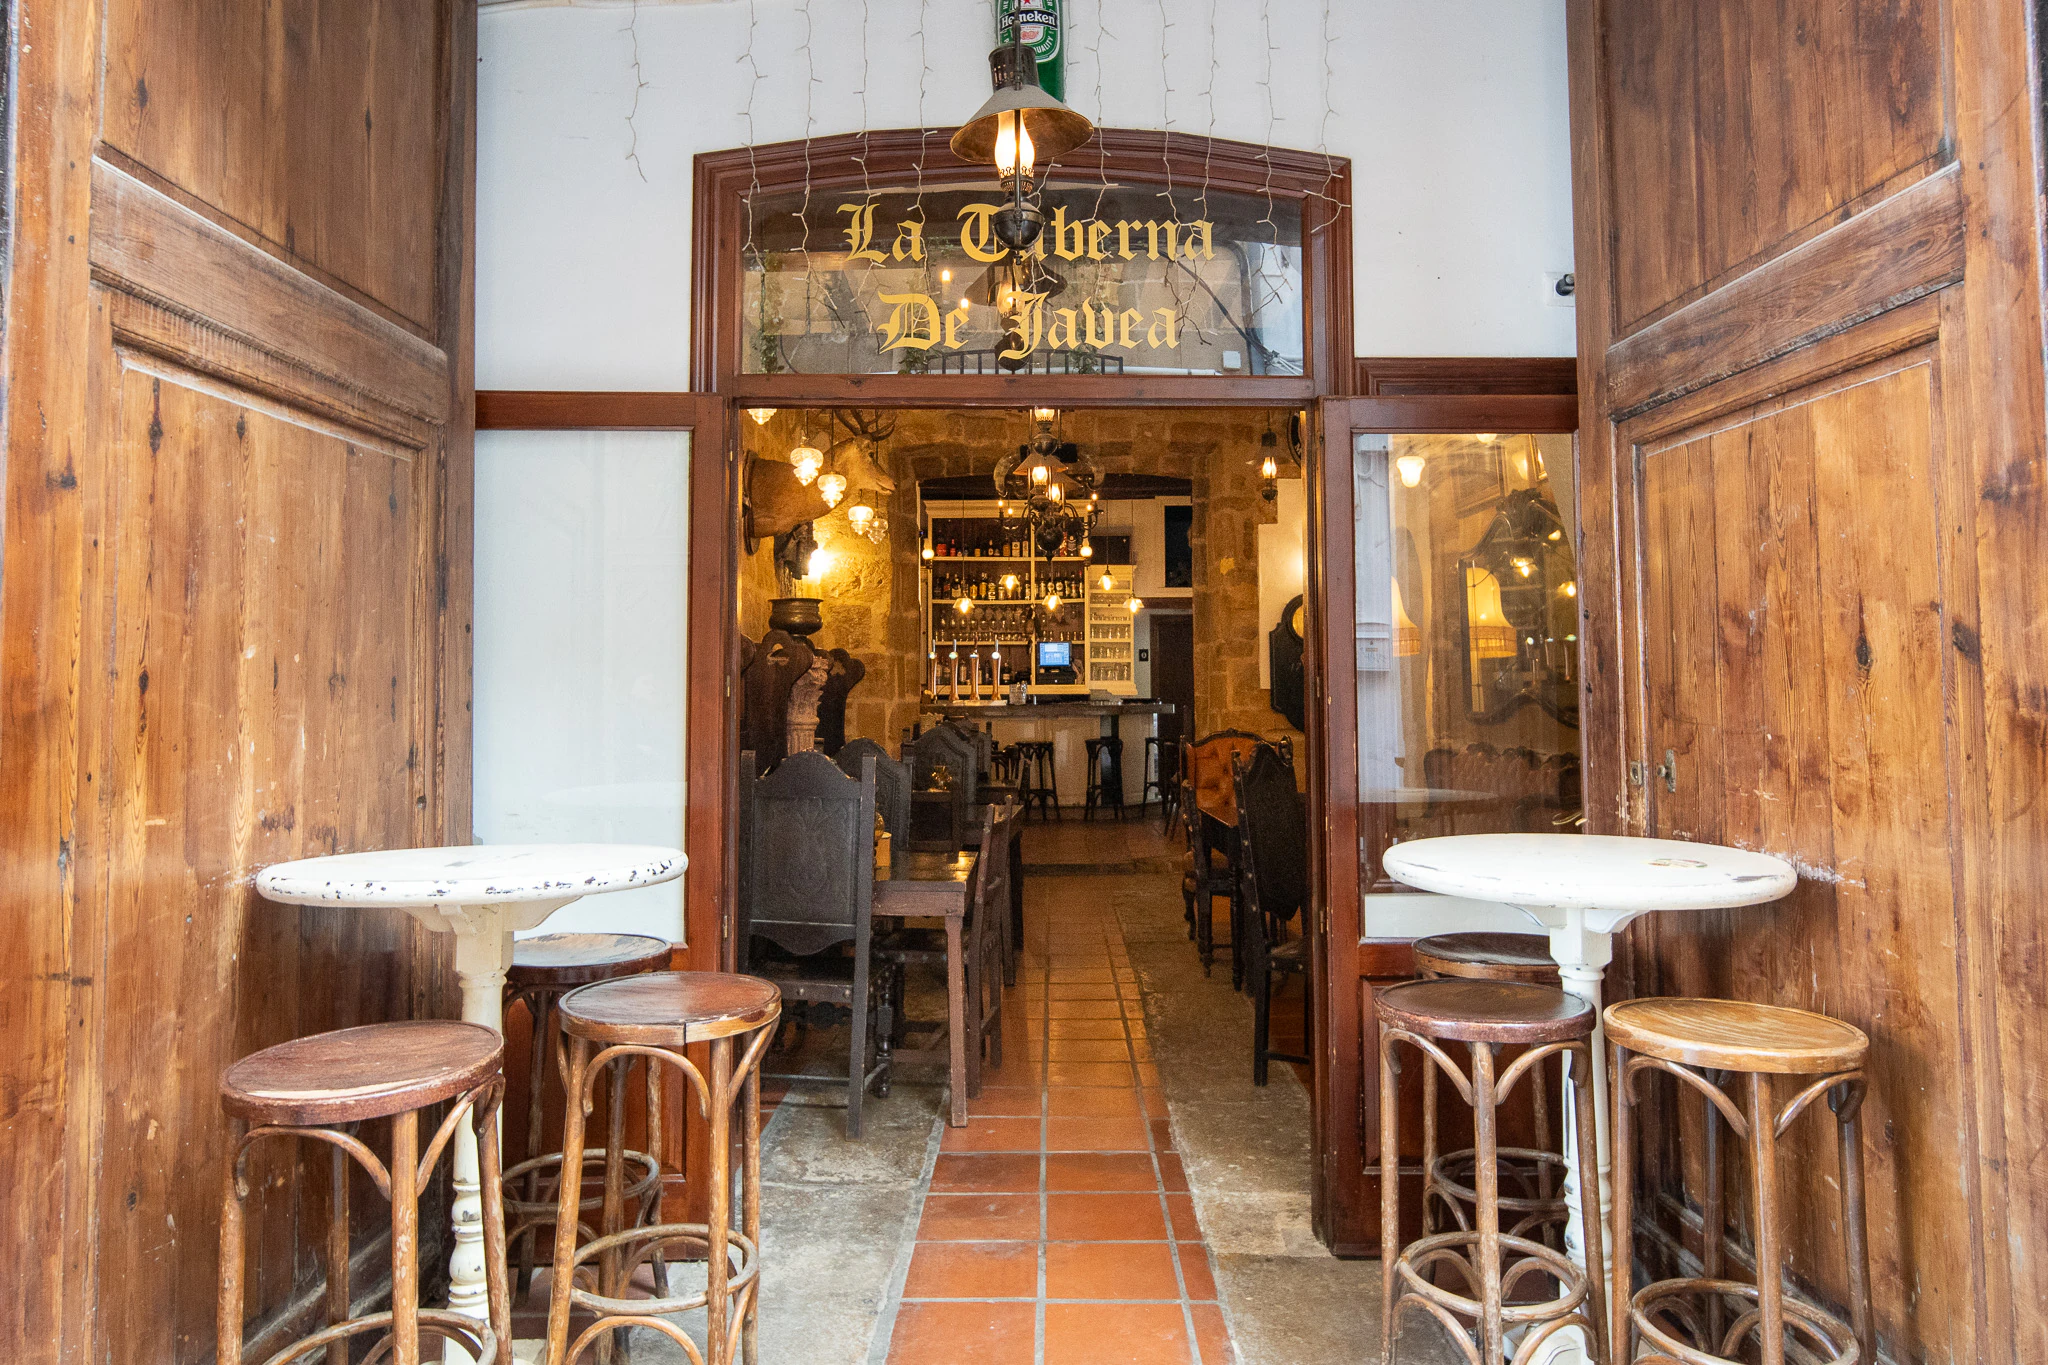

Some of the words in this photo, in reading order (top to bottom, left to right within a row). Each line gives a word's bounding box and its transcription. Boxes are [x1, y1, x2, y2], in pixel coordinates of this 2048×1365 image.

[1001, 11, 1056, 29] Heneken
[836, 203, 926, 264] La
[956, 203, 1217, 262] Tberna
[876, 290, 970, 355] De
[997, 291, 1181, 361] Javea
